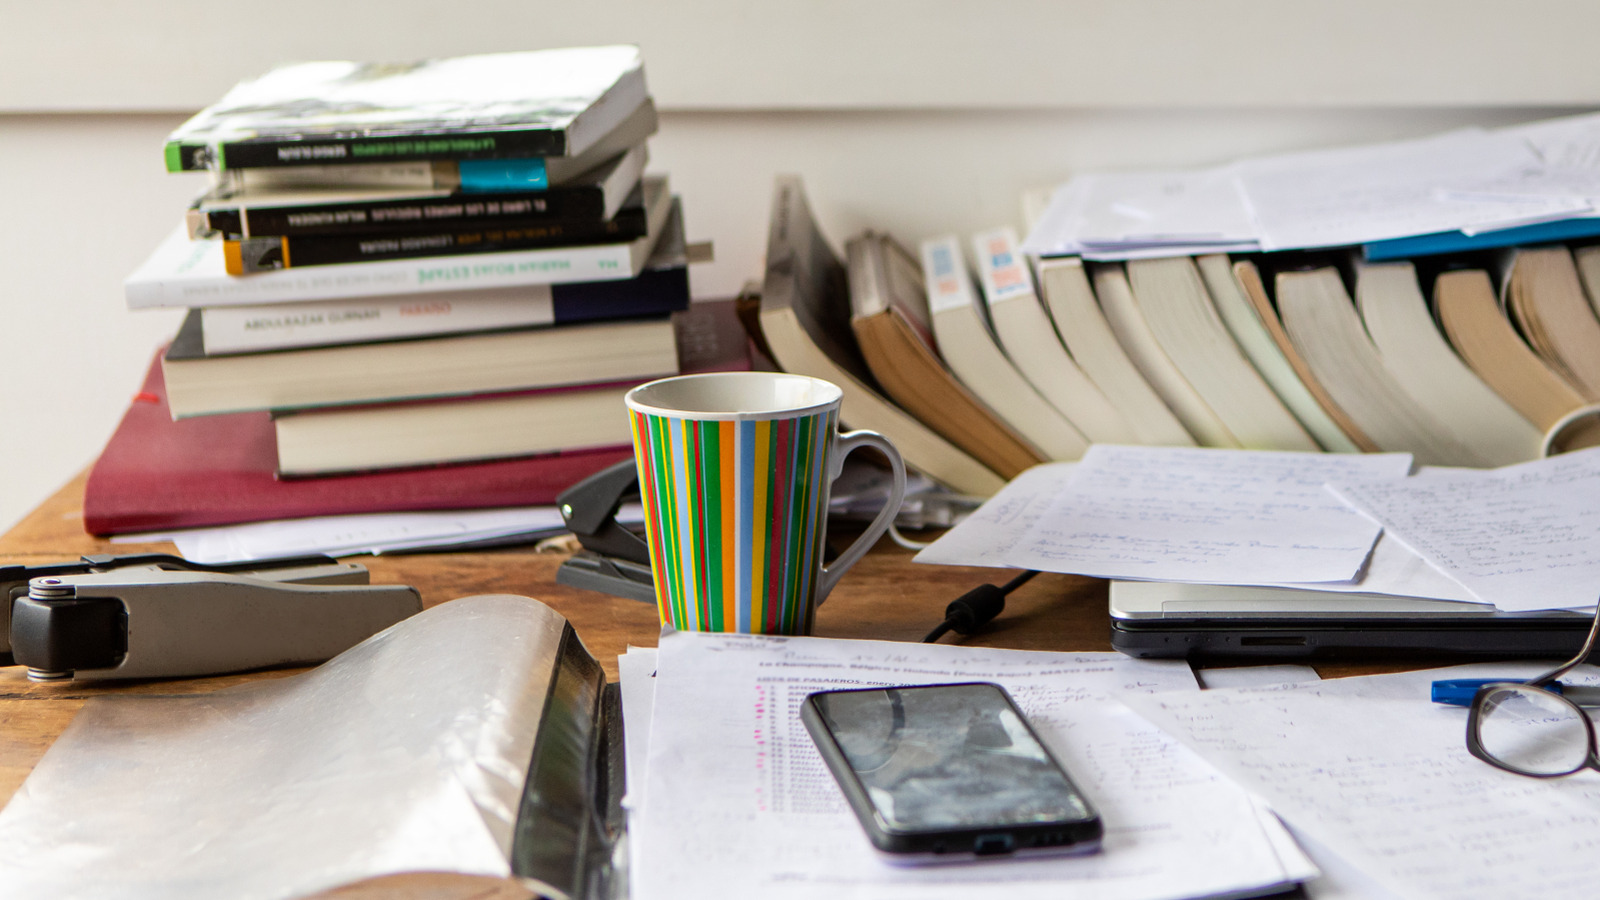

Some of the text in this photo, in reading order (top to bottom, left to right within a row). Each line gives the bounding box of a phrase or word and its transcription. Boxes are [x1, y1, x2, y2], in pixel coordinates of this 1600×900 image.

[424, 204, 463, 219] AMORES
[465, 203, 485, 217] LOS
[486, 202, 500, 215] DE
[502, 200, 532, 215] LIBRO
[533, 199, 547, 213] EL
[287, 213, 334, 227] KUNDERA
[335, 210, 367, 224] MILAN
[359, 240, 400, 254] PADURA
[473, 263, 516, 278] ROJAS
[518, 260, 571, 275] MARIAN
[417, 266, 471, 285] ESTAPÉ
[327, 308, 381, 325] GURNAH
